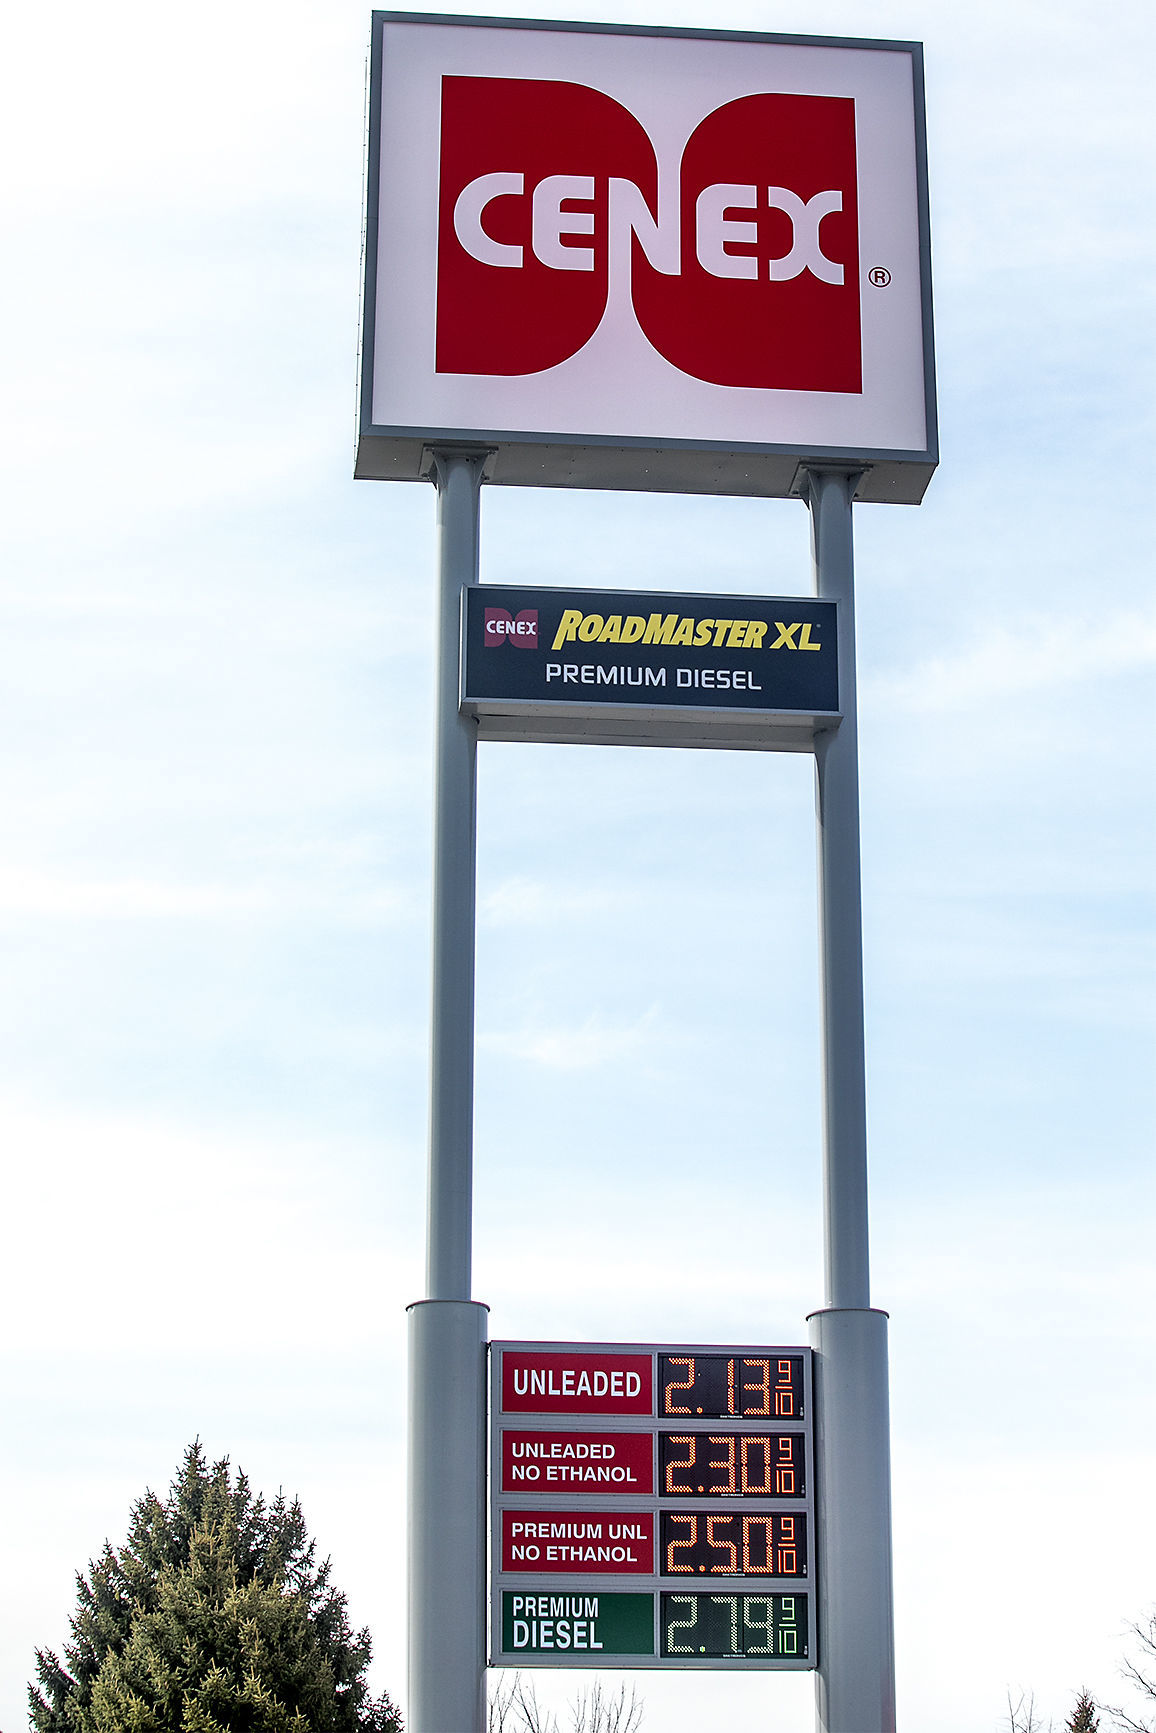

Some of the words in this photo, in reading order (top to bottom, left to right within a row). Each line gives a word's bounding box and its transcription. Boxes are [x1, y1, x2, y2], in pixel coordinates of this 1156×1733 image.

[454, 173, 844, 286] CENEX
[487, 620, 536, 635] CENEX
[769, 622, 821, 651] XL
[546, 663, 666, 687] PREMIUM
[677, 668, 762, 690] DIESEL
[513, 1369, 641, 1396] UNLEADED
[665, 1357, 770, 1415] 2.13
[512, 1443, 615, 1459] UNLEADED
[666, 1436, 771, 1493] 2.30
[512, 1466, 540, 1480] NO
[546, 1466, 637, 1482] ETHANOL
[512, 1523, 602, 1539] PREMIUM
[609, 1524, 647, 1540] UNL
[667, 1516, 773, 1573] 2.50
[512, 1546, 540, 1560] NO
[546, 1546, 637, 1562] ETHANOL
[513, 1597, 599, 1618] PREMIUM
[513, 1620, 603, 1649] DIESEL
[668, 1596, 773, 1653] 2.79
